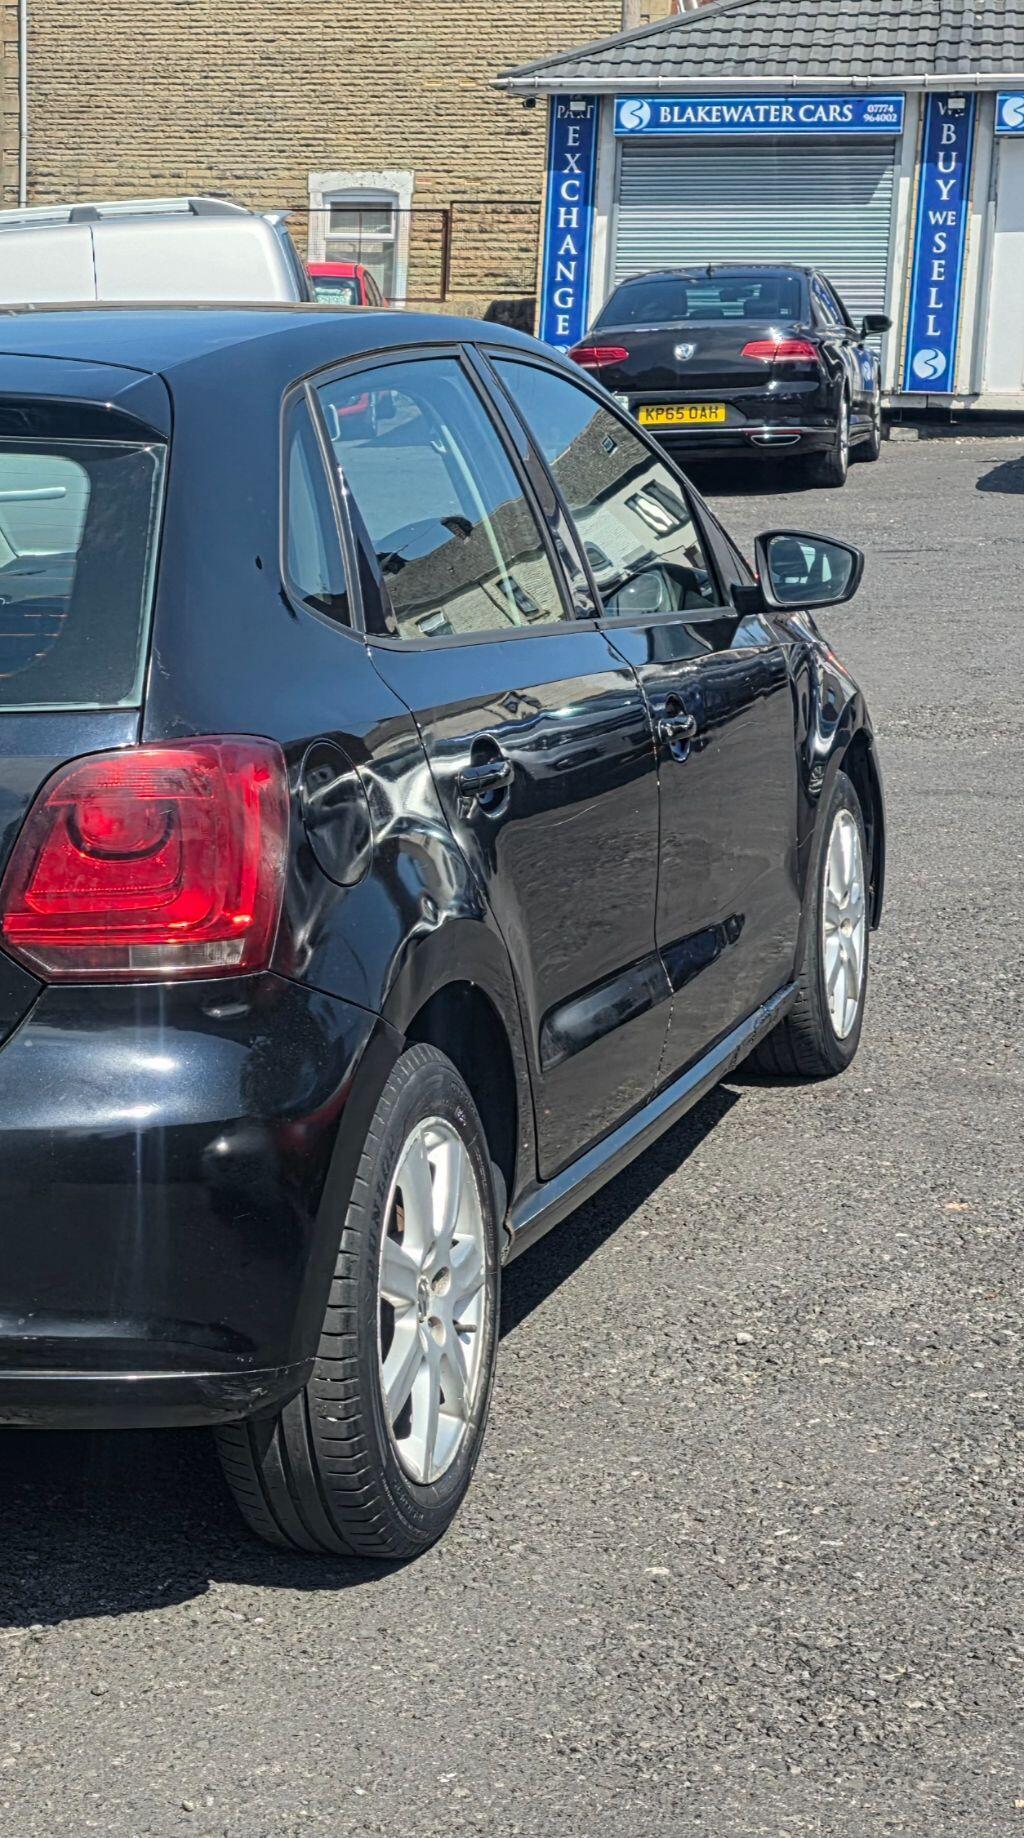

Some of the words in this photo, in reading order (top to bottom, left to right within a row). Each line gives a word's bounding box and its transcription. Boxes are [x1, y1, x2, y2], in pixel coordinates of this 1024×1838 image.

[557, 105, 594, 118] PAT
[659, 105, 796, 123] BLAKEWATER
[799, 104, 853, 122] CARS
[936, 123, 957, 200] BUY
[928, 210, 956, 226] WE
[553, 125, 582, 335] EXCHANGE
[926, 232, 947, 336] SELL
[645, 406, 684, 421] KP65
